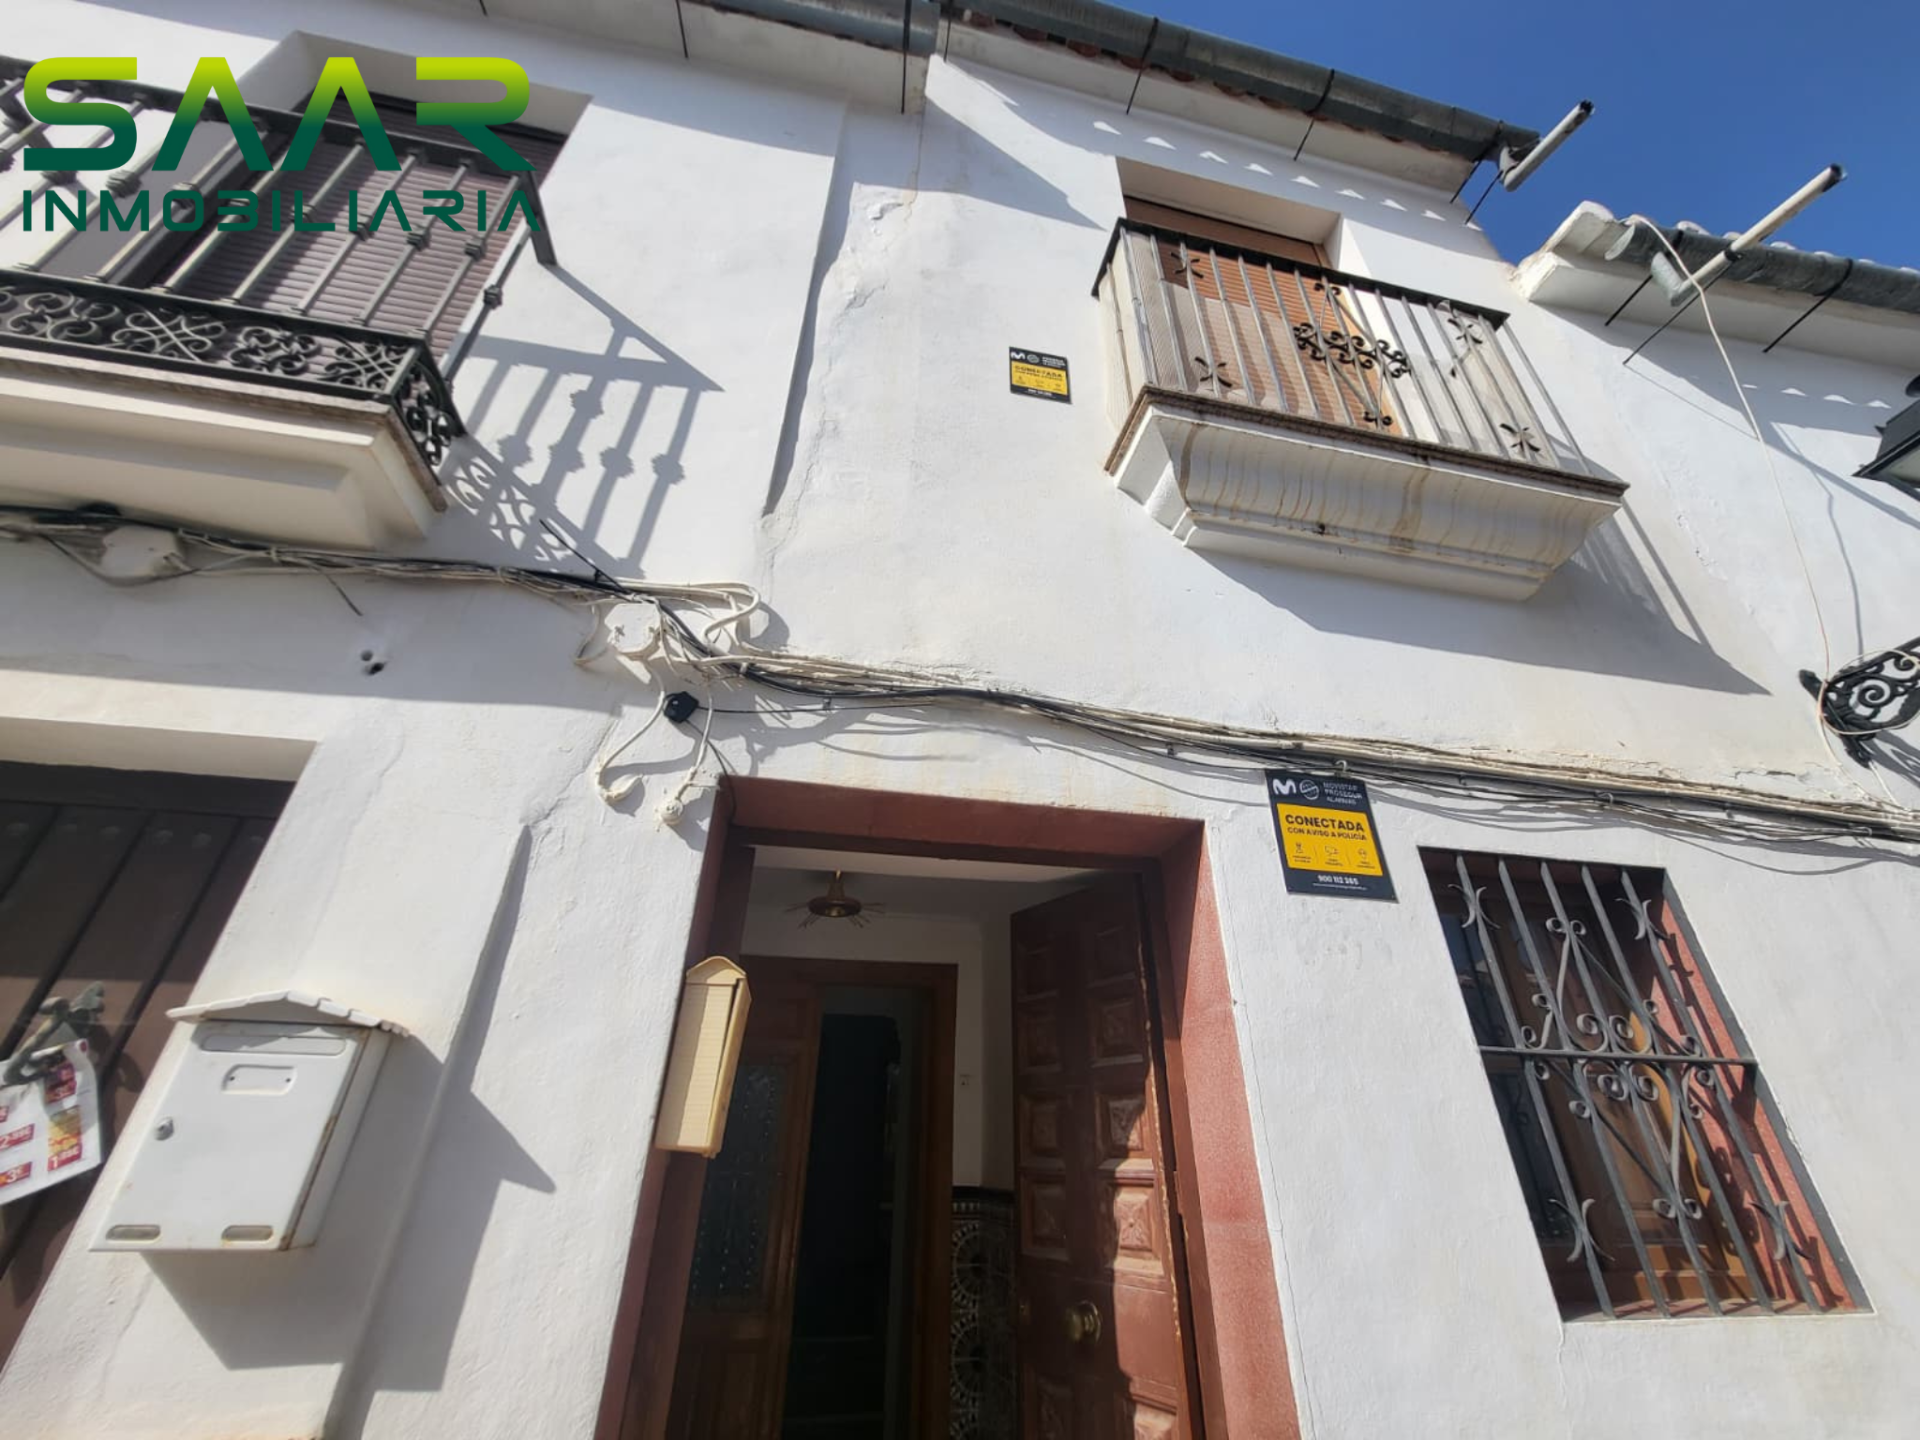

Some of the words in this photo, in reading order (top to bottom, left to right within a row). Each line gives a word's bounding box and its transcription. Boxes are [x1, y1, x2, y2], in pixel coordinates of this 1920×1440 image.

[1284, 814, 1365, 832] CONECTADA
[1287, 826, 1305, 835] CON
[1306, 828, 1330, 837] AVISO
